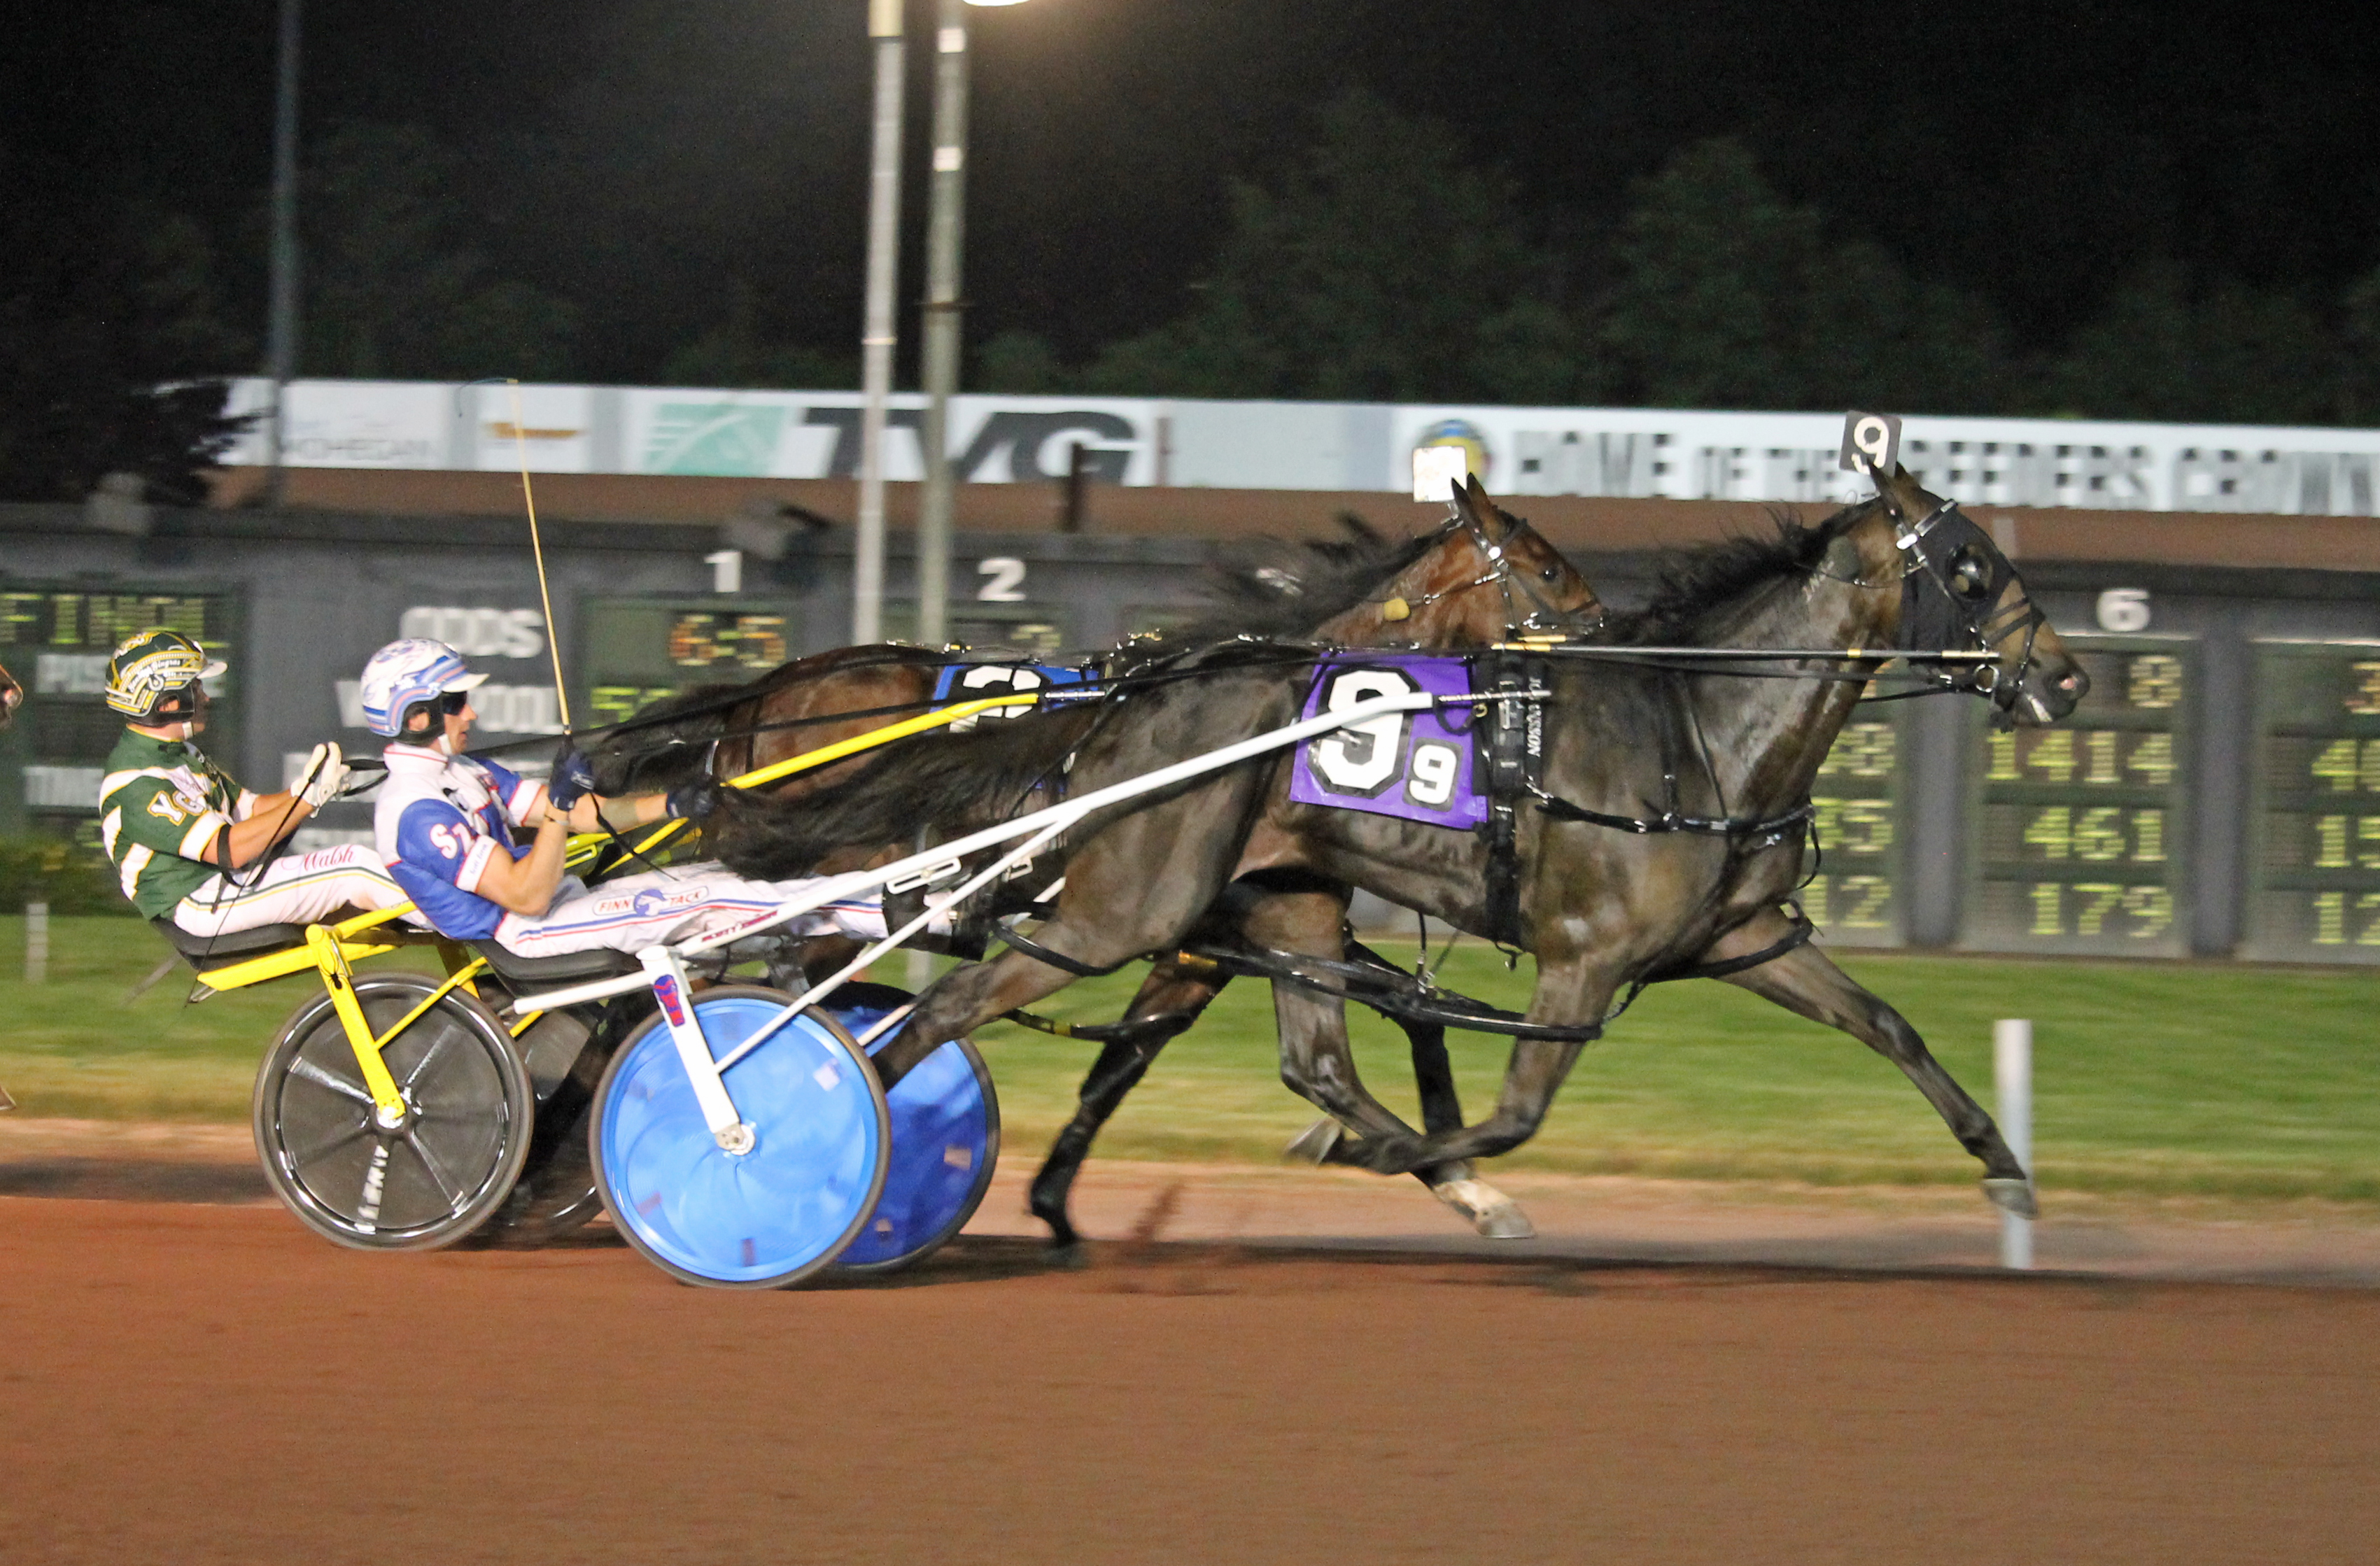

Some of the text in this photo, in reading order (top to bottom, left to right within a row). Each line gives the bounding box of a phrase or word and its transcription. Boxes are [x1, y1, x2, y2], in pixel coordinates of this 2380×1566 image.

[803, 407, 1135, 484] TVG
[1851, 416, 1889, 475] 9
[1896, 440, 2153, 512] REEDERS
[703, 551, 742, 593] 1
[978, 556, 1027, 602] 2
[2097, 588, 2150, 632] 6
[670, 614, 785, 667] 6-5
[2129, 655, 2183, 708] 8
[1318, 670, 1411, 790] 9
[1986, 728, 2178, 784] 1414
[1409, 745, 1457, 805] 9
[294, 845, 356, 871] Walsh
[2025, 806, 2168, 862] 461
[599, 891, 702, 912] FINN TACK
[2031, 882, 2174, 938] 179
